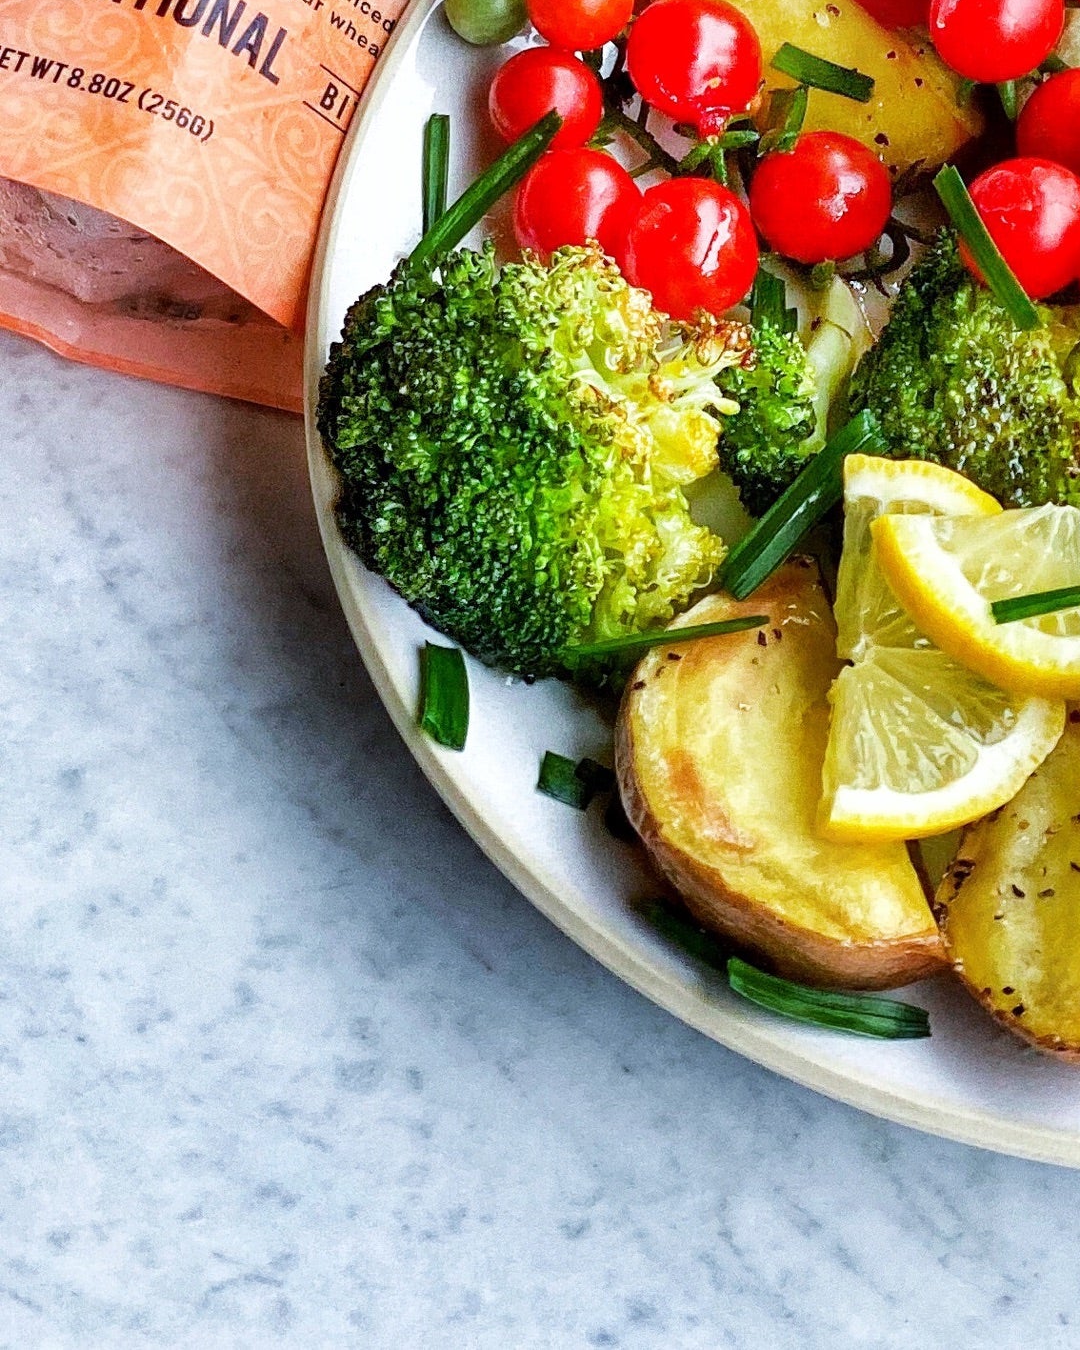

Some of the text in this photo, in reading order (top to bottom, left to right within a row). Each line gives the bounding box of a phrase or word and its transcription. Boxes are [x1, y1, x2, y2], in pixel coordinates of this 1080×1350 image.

[330, 10, 379, 58] whea
[0, 46, 30, 72] ET
[138, 88, 215, 143] (256G)
[319, 81, 360, 120] BI
